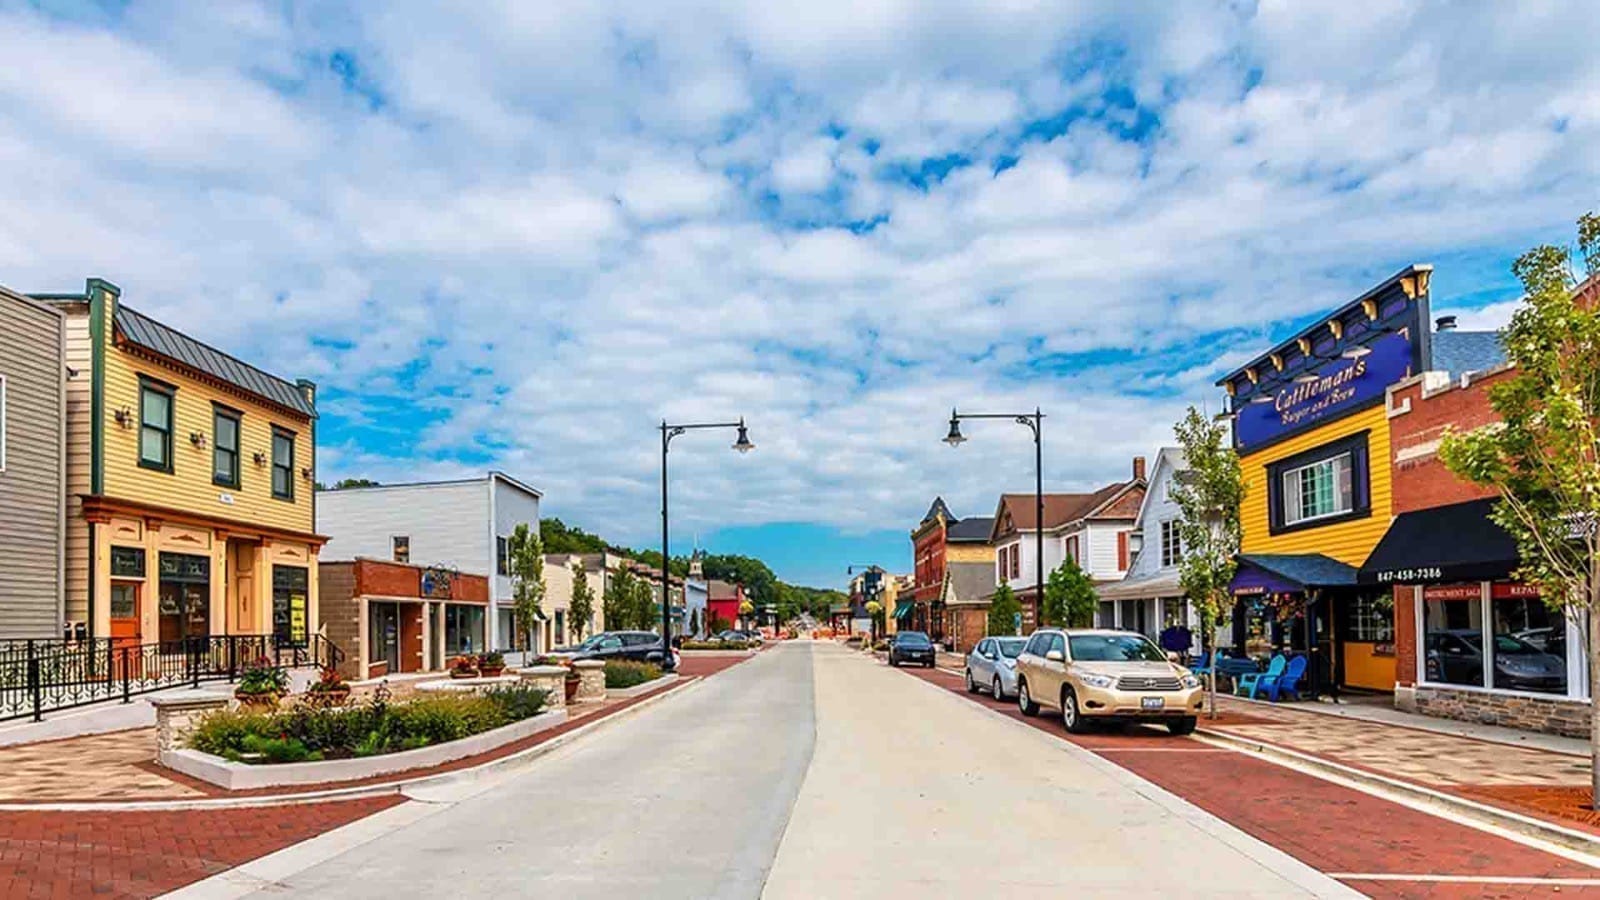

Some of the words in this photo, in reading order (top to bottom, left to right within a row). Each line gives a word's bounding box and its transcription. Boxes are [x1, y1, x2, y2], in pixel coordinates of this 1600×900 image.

[1275, 361, 1367, 412] Cattleman's
[1312, 395, 1330, 413] and
[1377, 567, 1442, 582] 847-458-7386
